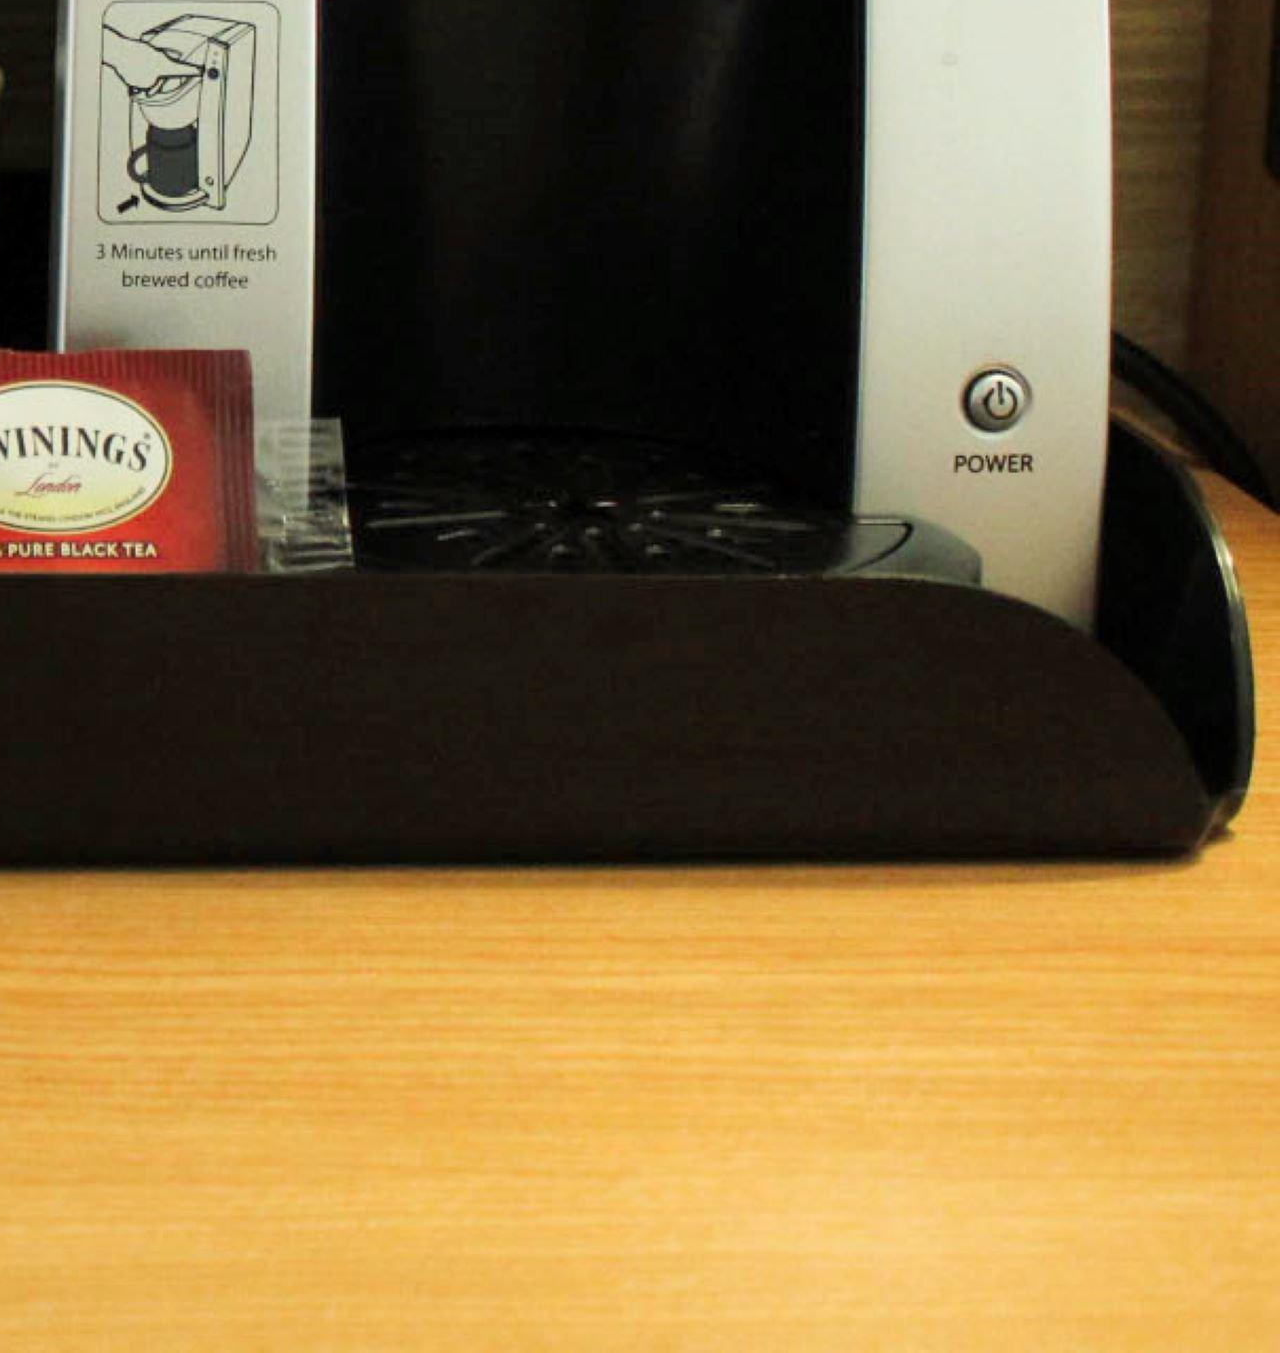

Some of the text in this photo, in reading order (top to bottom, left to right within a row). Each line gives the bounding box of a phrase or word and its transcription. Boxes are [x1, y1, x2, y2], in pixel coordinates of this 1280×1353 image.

[95, 243, 277, 262] 3 Minutes until fresh
[121, 269, 249, 289] brewed coffee
[953, 454, 1034, 474] POWER
[14, 472, 83, 498] London
[7, 542, 55, 558] PURE
[60, 542, 120, 558] BLACK
[121, 542, 158, 558] TEA
